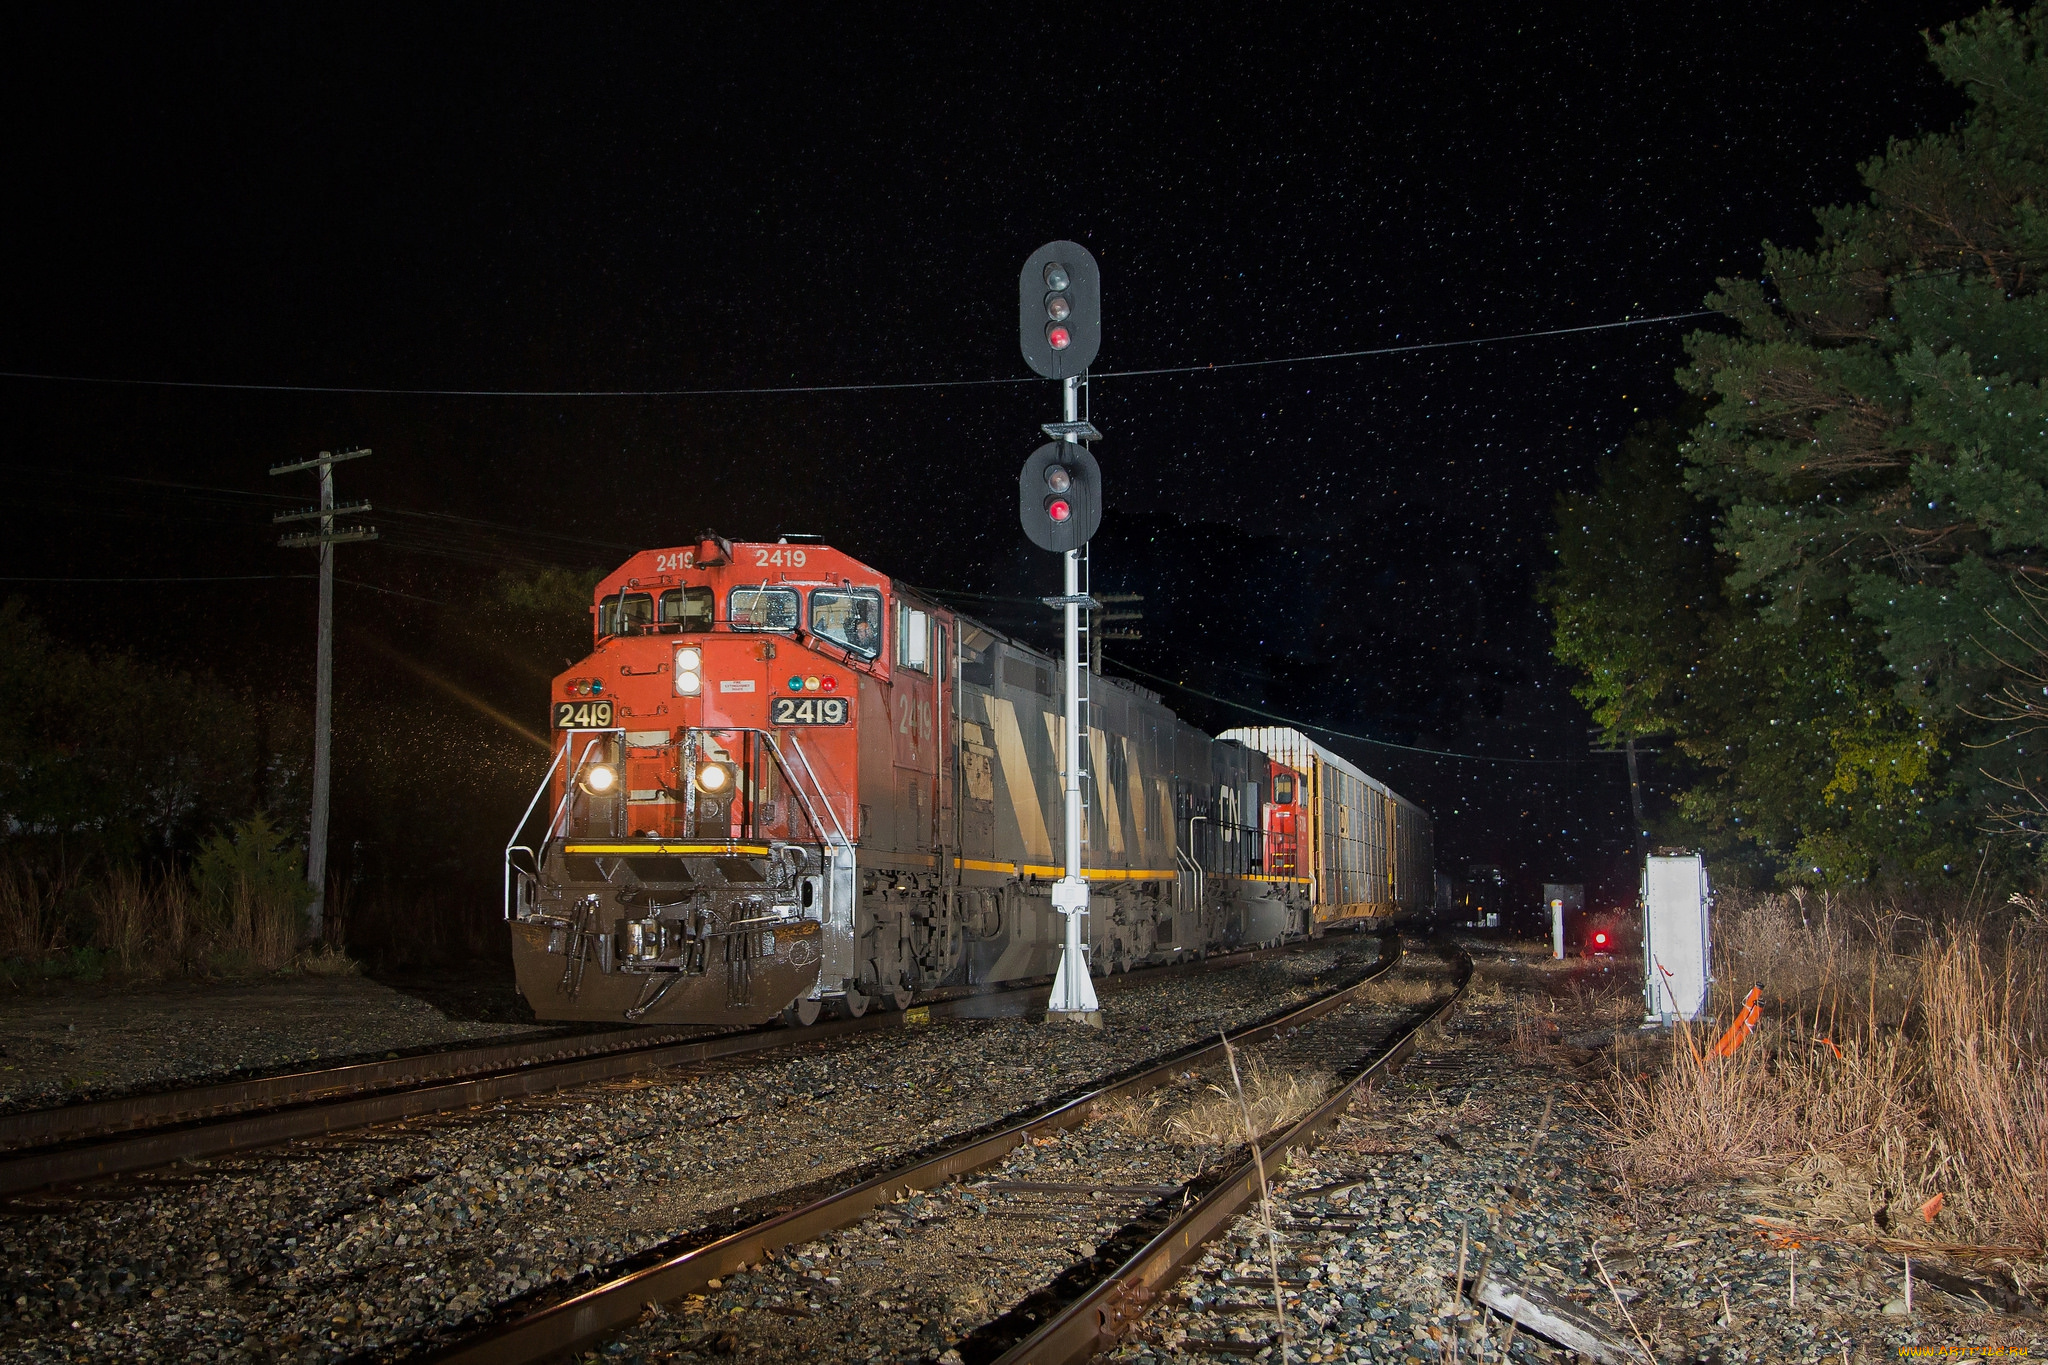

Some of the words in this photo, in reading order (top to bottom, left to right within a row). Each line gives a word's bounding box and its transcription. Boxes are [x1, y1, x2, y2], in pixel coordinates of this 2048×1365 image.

[656, 551, 694, 573] 2419
[755, 549, 806, 568] 2419
[558, 703, 612, 727] 2419
[776, 699, 843, 724] 2419
[900, 693, 932, 741] 2419
[1219, 784, 1241, 844] CN
